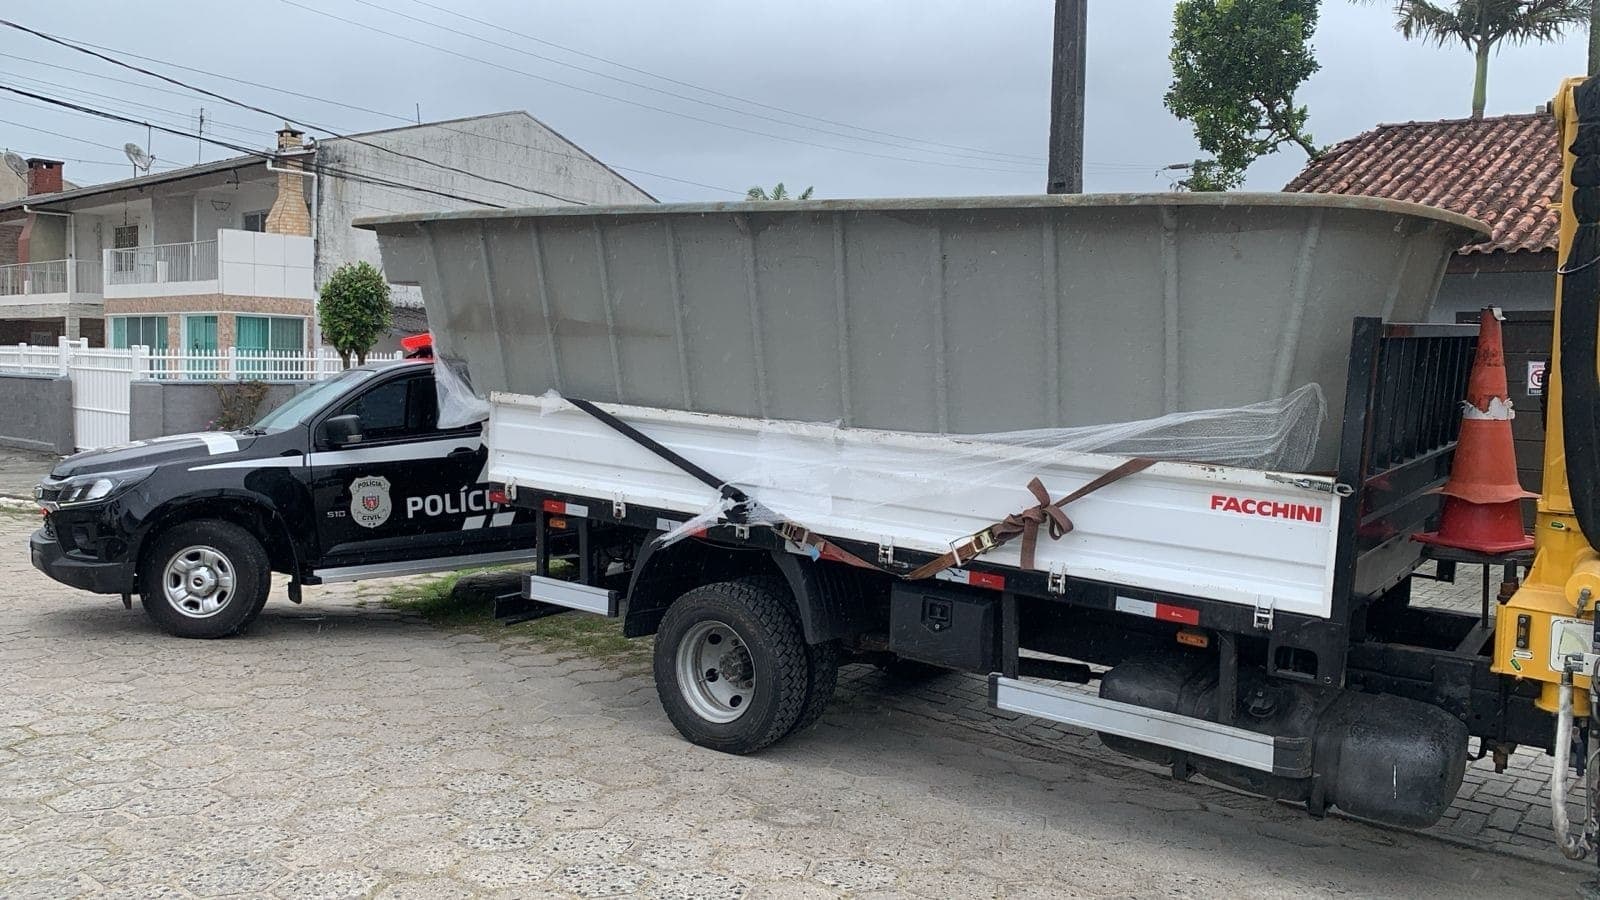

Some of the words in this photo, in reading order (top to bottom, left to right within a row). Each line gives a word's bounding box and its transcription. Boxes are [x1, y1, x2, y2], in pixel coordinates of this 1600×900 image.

[358, 480, 382, 488] POLÍCIA
[407, 485, 510, 519] POLÍCI
[1210, 495, 1322, 523] FACCHINI
[327, 510, 346, 518] S10
